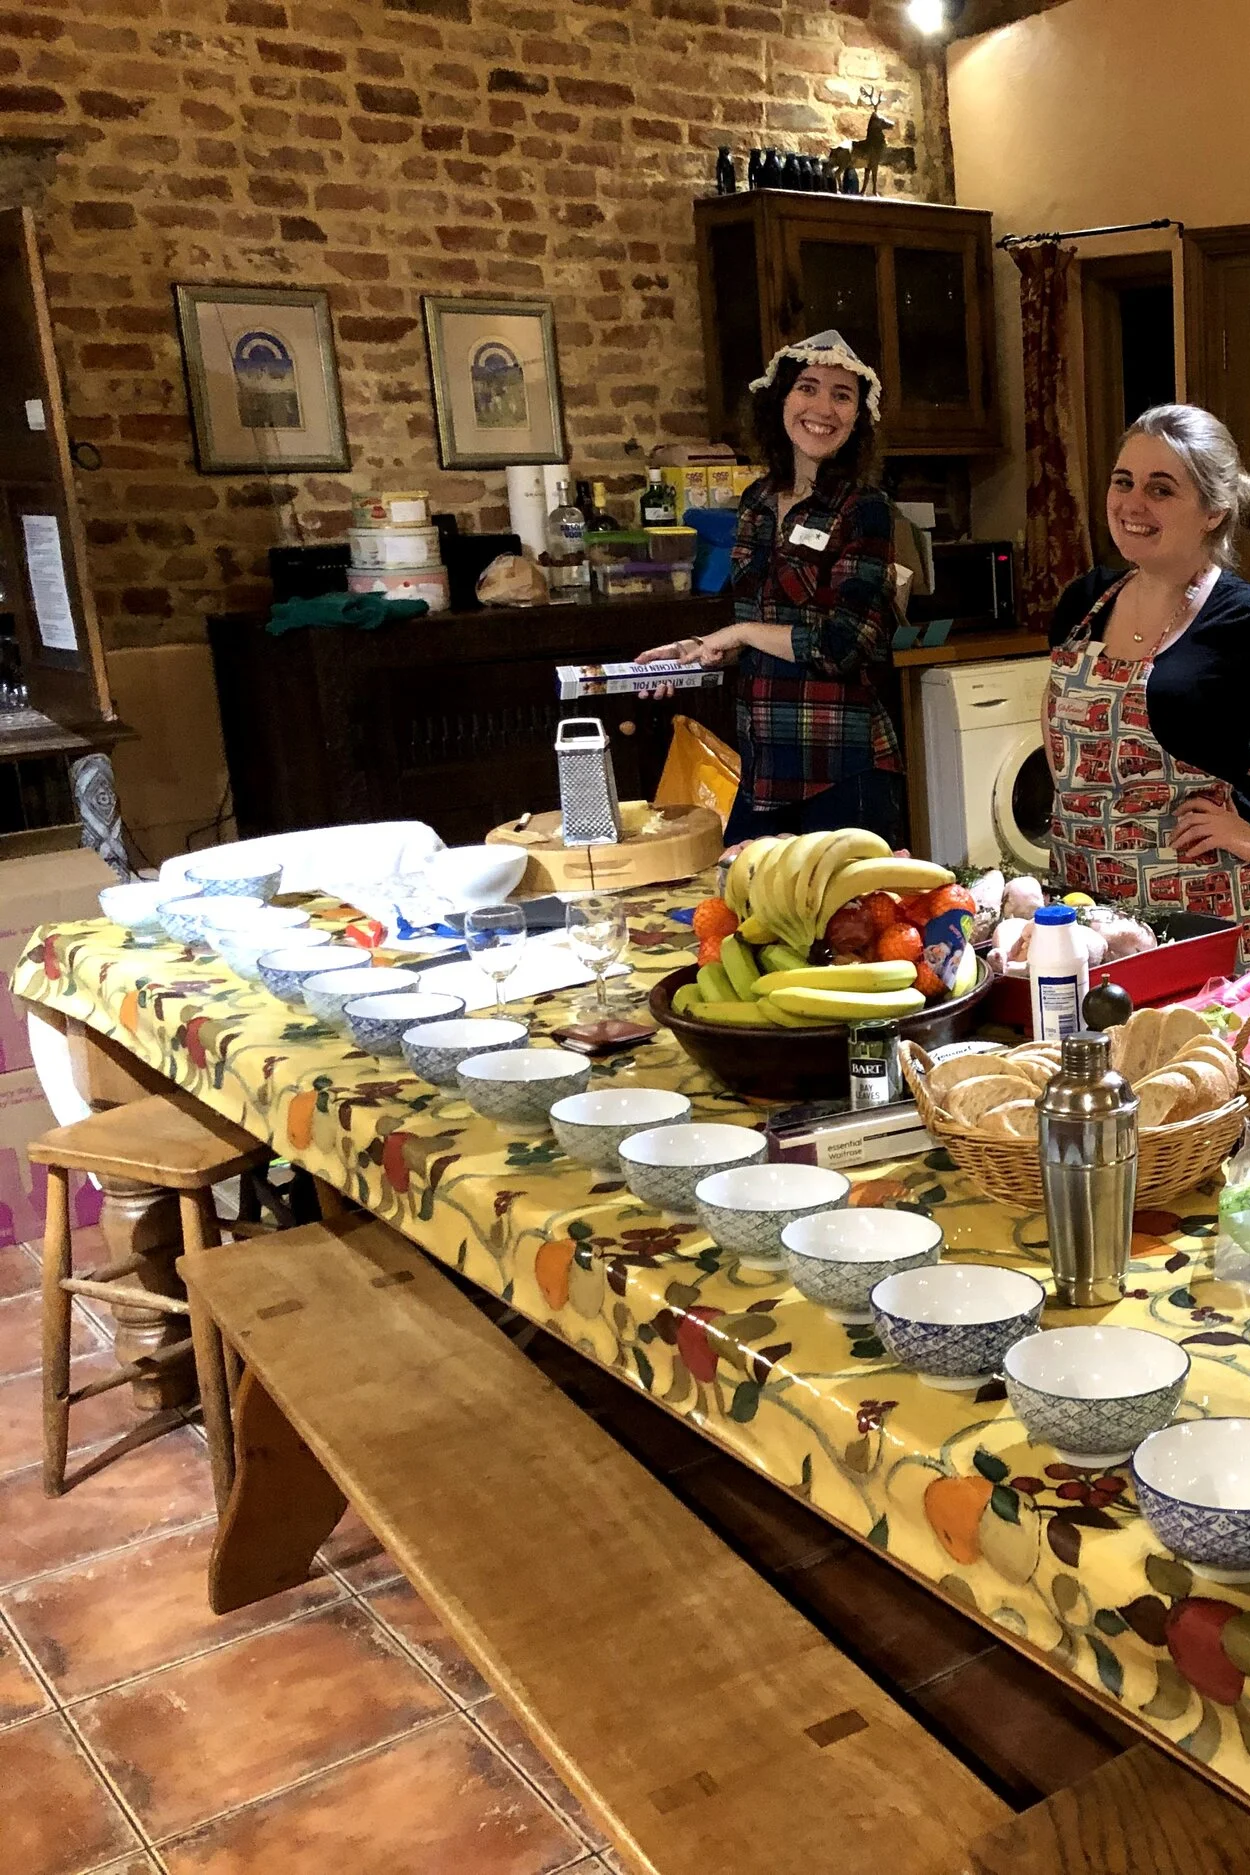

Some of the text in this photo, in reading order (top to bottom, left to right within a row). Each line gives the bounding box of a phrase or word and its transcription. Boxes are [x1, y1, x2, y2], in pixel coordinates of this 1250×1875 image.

[632, 681, 649, 690] FOIL
[852, 1063, 882, 1075] BART
[856, 1091, 880, 1100] LEAVES
[827, 1138, 862, 1152] essential
[828, 1149, 863, 1160] Waitrose
